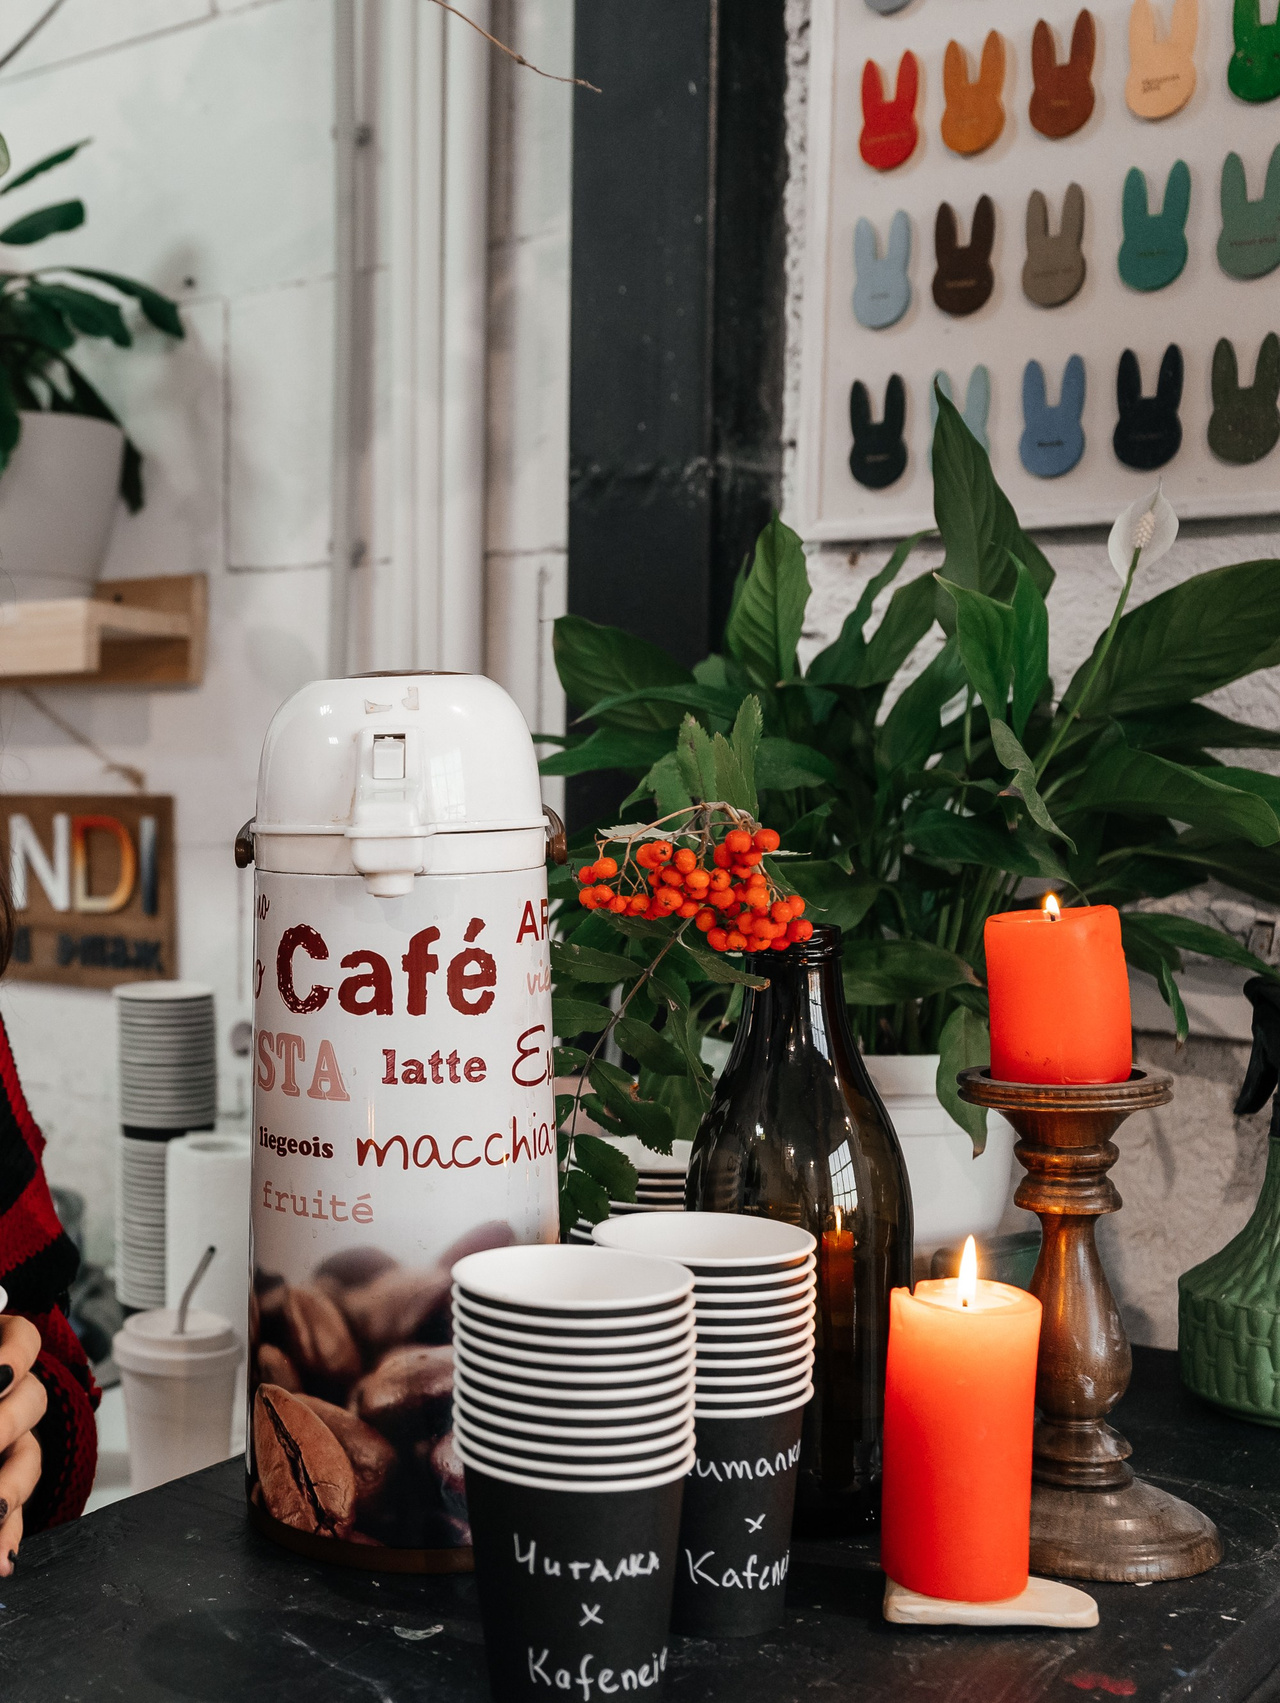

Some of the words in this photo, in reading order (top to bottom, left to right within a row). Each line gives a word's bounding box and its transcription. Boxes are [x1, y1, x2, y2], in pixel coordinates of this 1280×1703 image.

[276, 918, 497, 1016] Café
[254, 1028, 350, 1102] STA
[381, 1048, 488, 1085] latte
[258, 1125, 335, 1159] liegeois
[262, 1180, 375, 1225] fruité
